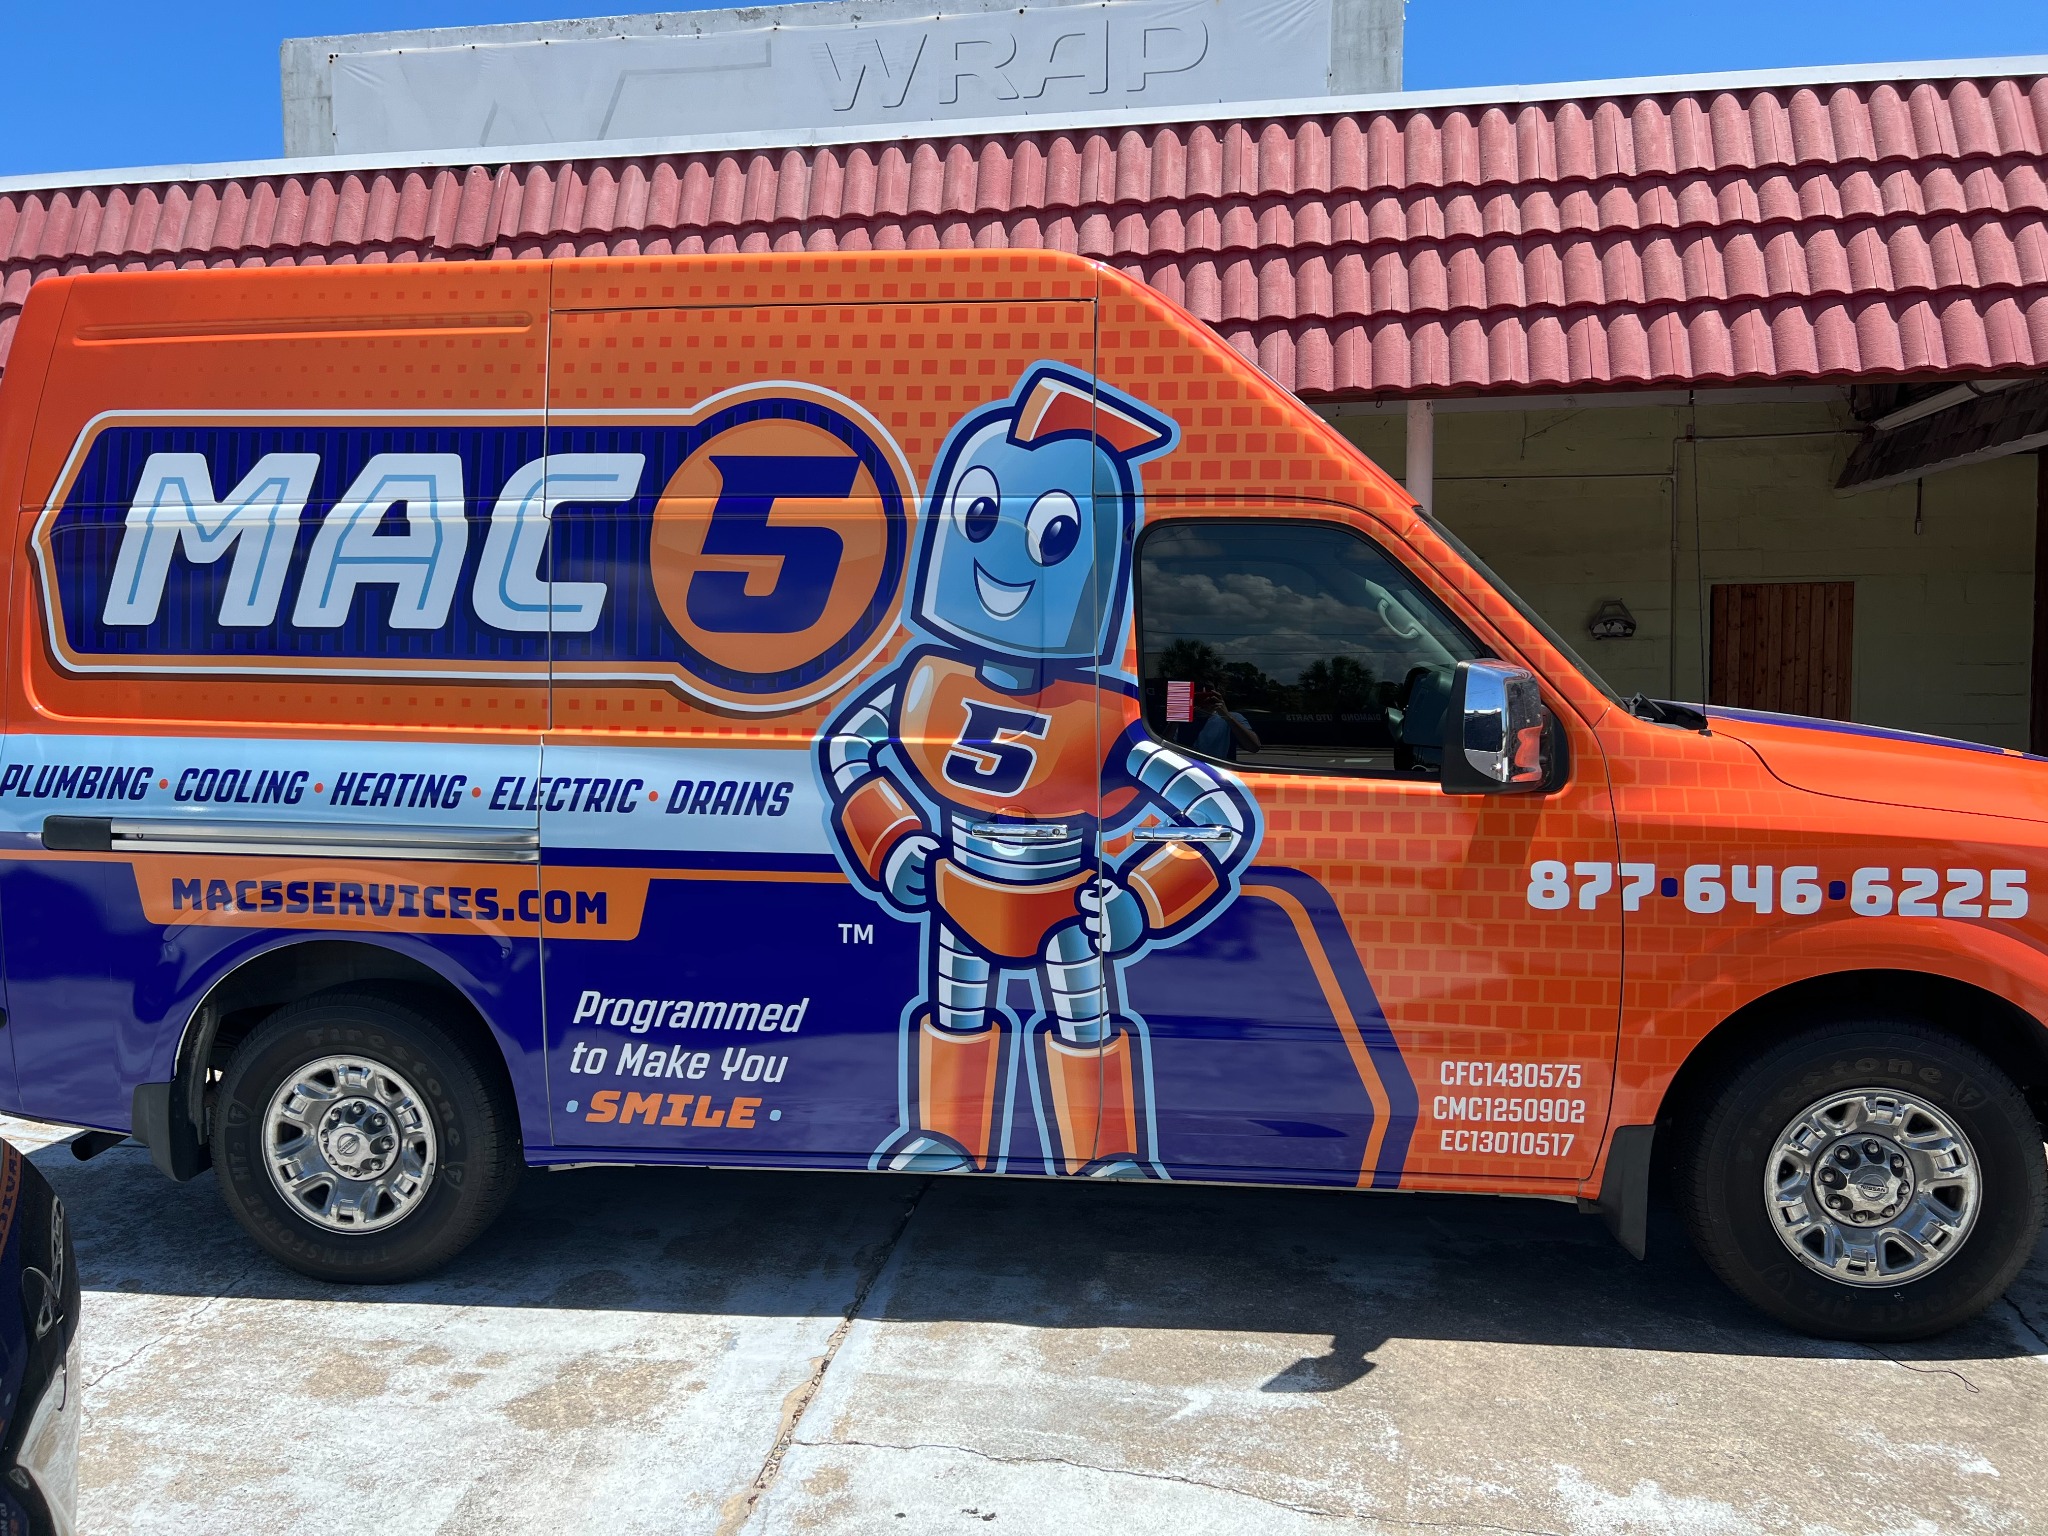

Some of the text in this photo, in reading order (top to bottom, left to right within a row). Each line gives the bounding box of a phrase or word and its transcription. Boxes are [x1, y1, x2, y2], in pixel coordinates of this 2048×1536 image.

[809, 20, 1209, 112] WRAP
[103, 452, 862, 634] MAC 5
[942, 697, 1052, 798] 5
[1, 764, 795, 817] PLUMBING COOLING HEATING ELECTRIC DRAINS
[171, 877, 608, 924] MAC5SERVICES.COM
[838, 923, 874, 945] TM
[573, 990, 810, 1034] Programmed
[569, 1041, 789, 1083] to Make You
[1439, 1061, 1582, 1089] CFC1430575
[585, 1090, 762, 1129] SMILE
[1432, 1096, 1586, 1124] CMC1250902
[1439, 1130, 1575, 1157] EC13010517
[1860, 1184, 1886, 1192] NISSAN
